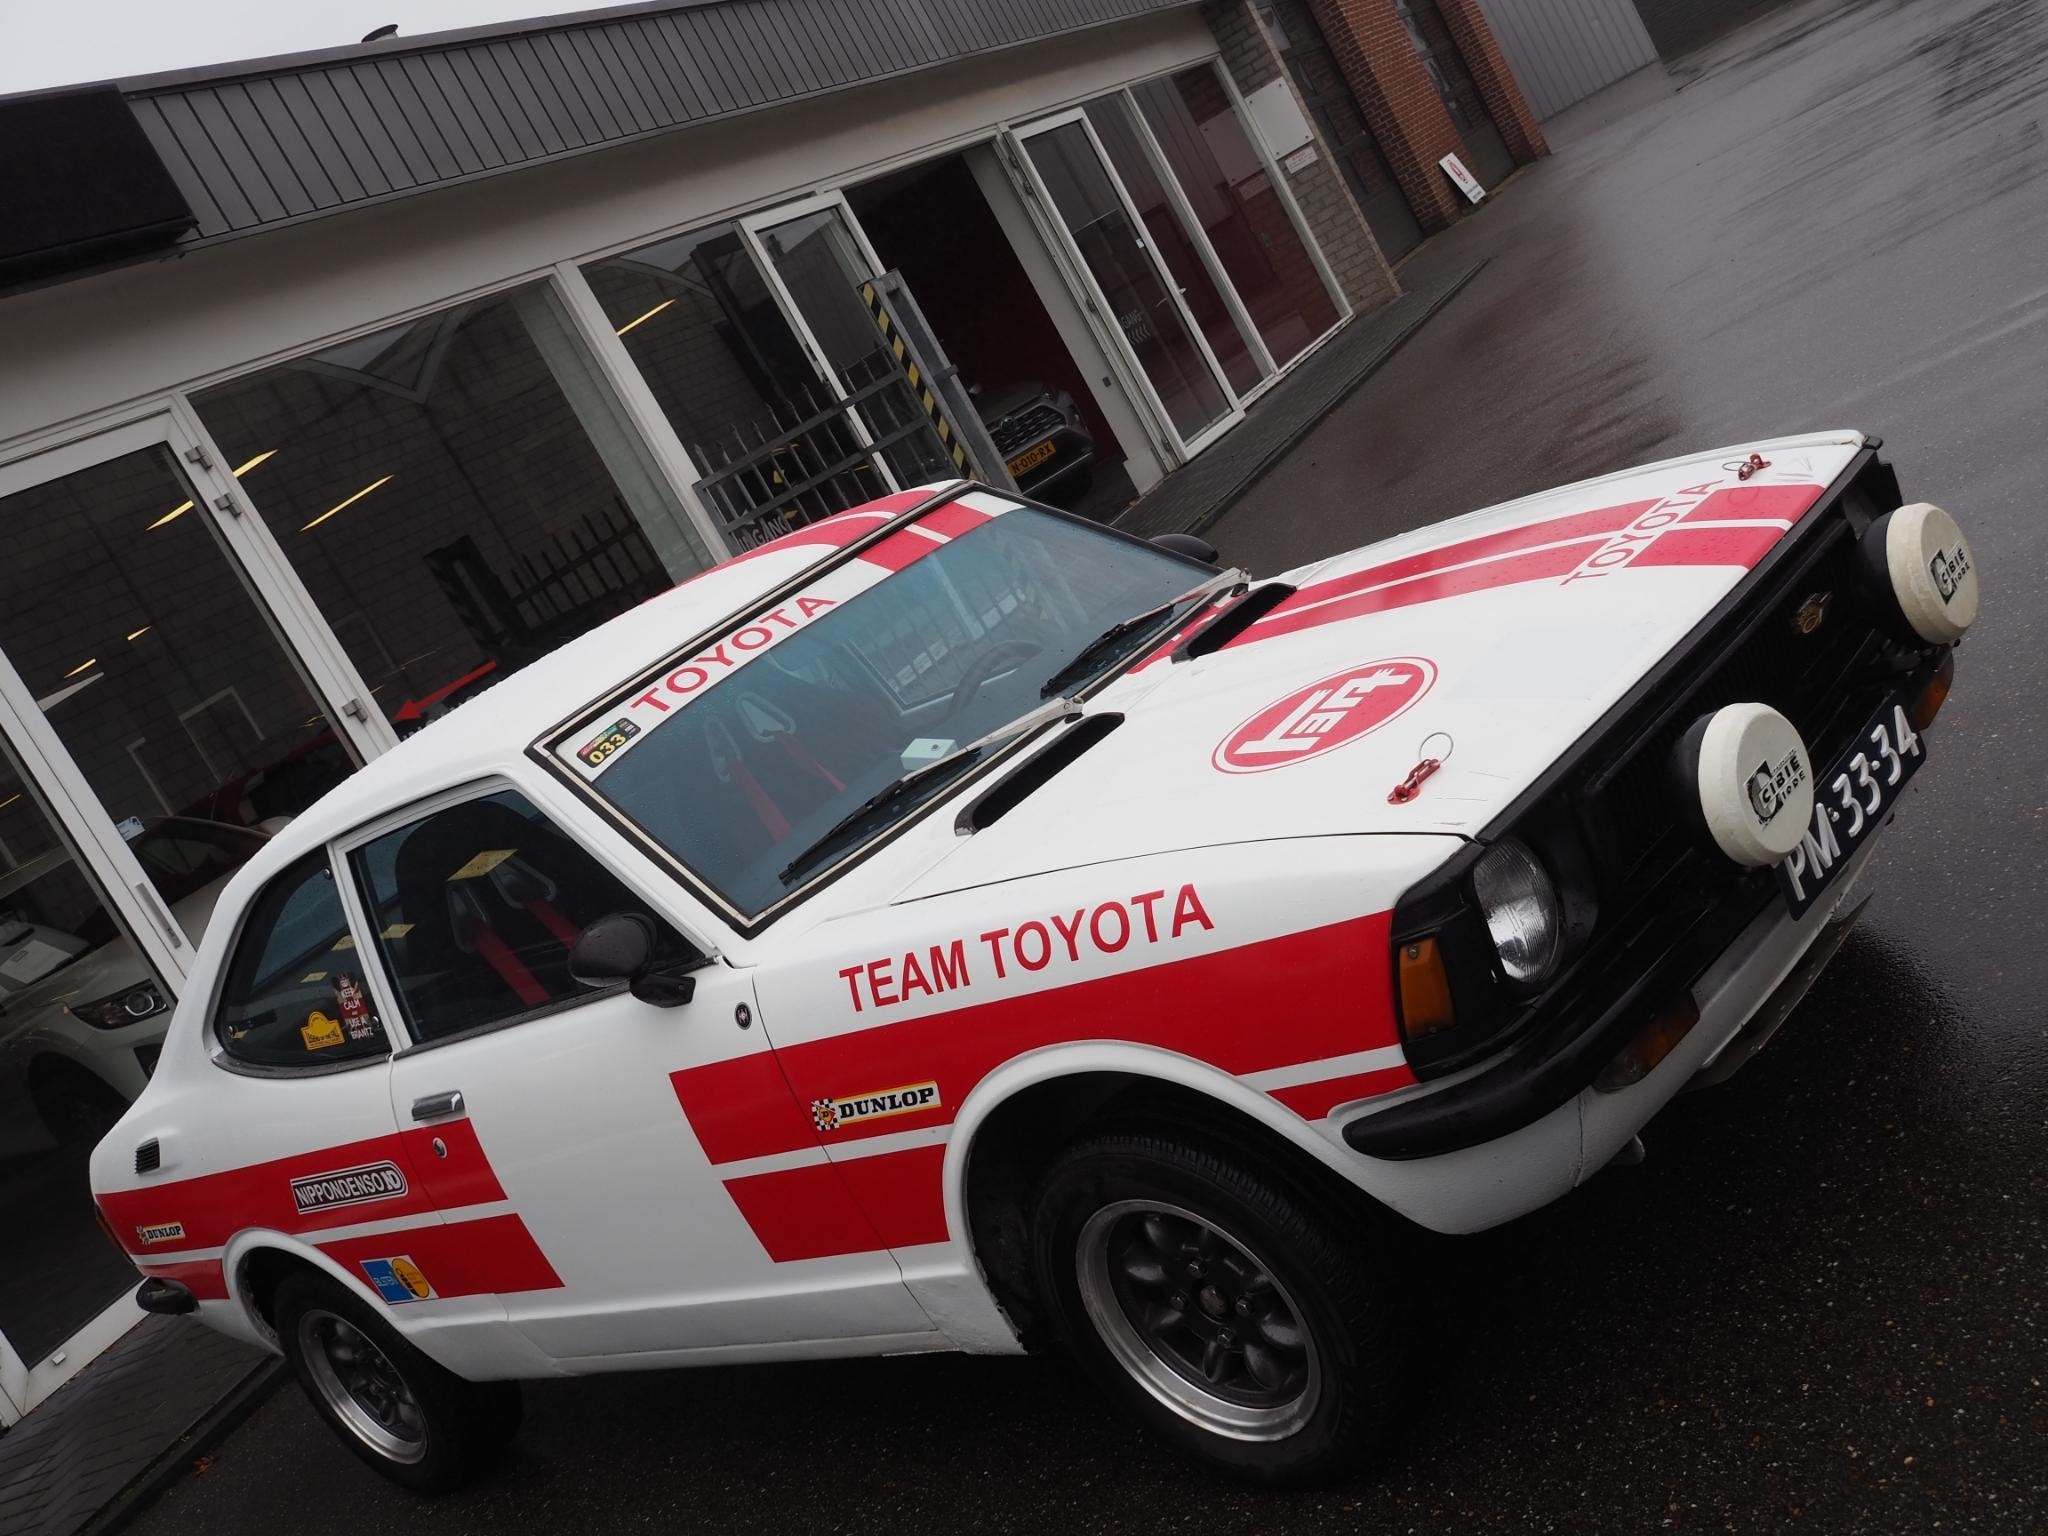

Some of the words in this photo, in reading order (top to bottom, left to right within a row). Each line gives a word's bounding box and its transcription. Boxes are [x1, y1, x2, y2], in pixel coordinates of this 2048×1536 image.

[1560, 479, 1725, 586] TOYOTA
[630, 597, 838, 712] TOYOTA
[589, 733, 627, 764] 033
[838, 939, 971, 1013] TEAM
[980, 883, 1215, 979] TOYOTA
[343, 999, 361, 1010] CALM
[838, 1086, 934, 1119] DUNLOP
[295, 1172, 385, 1206] NIPPONDENSO
[146, 1225, 182, 1239] DUNLOP
